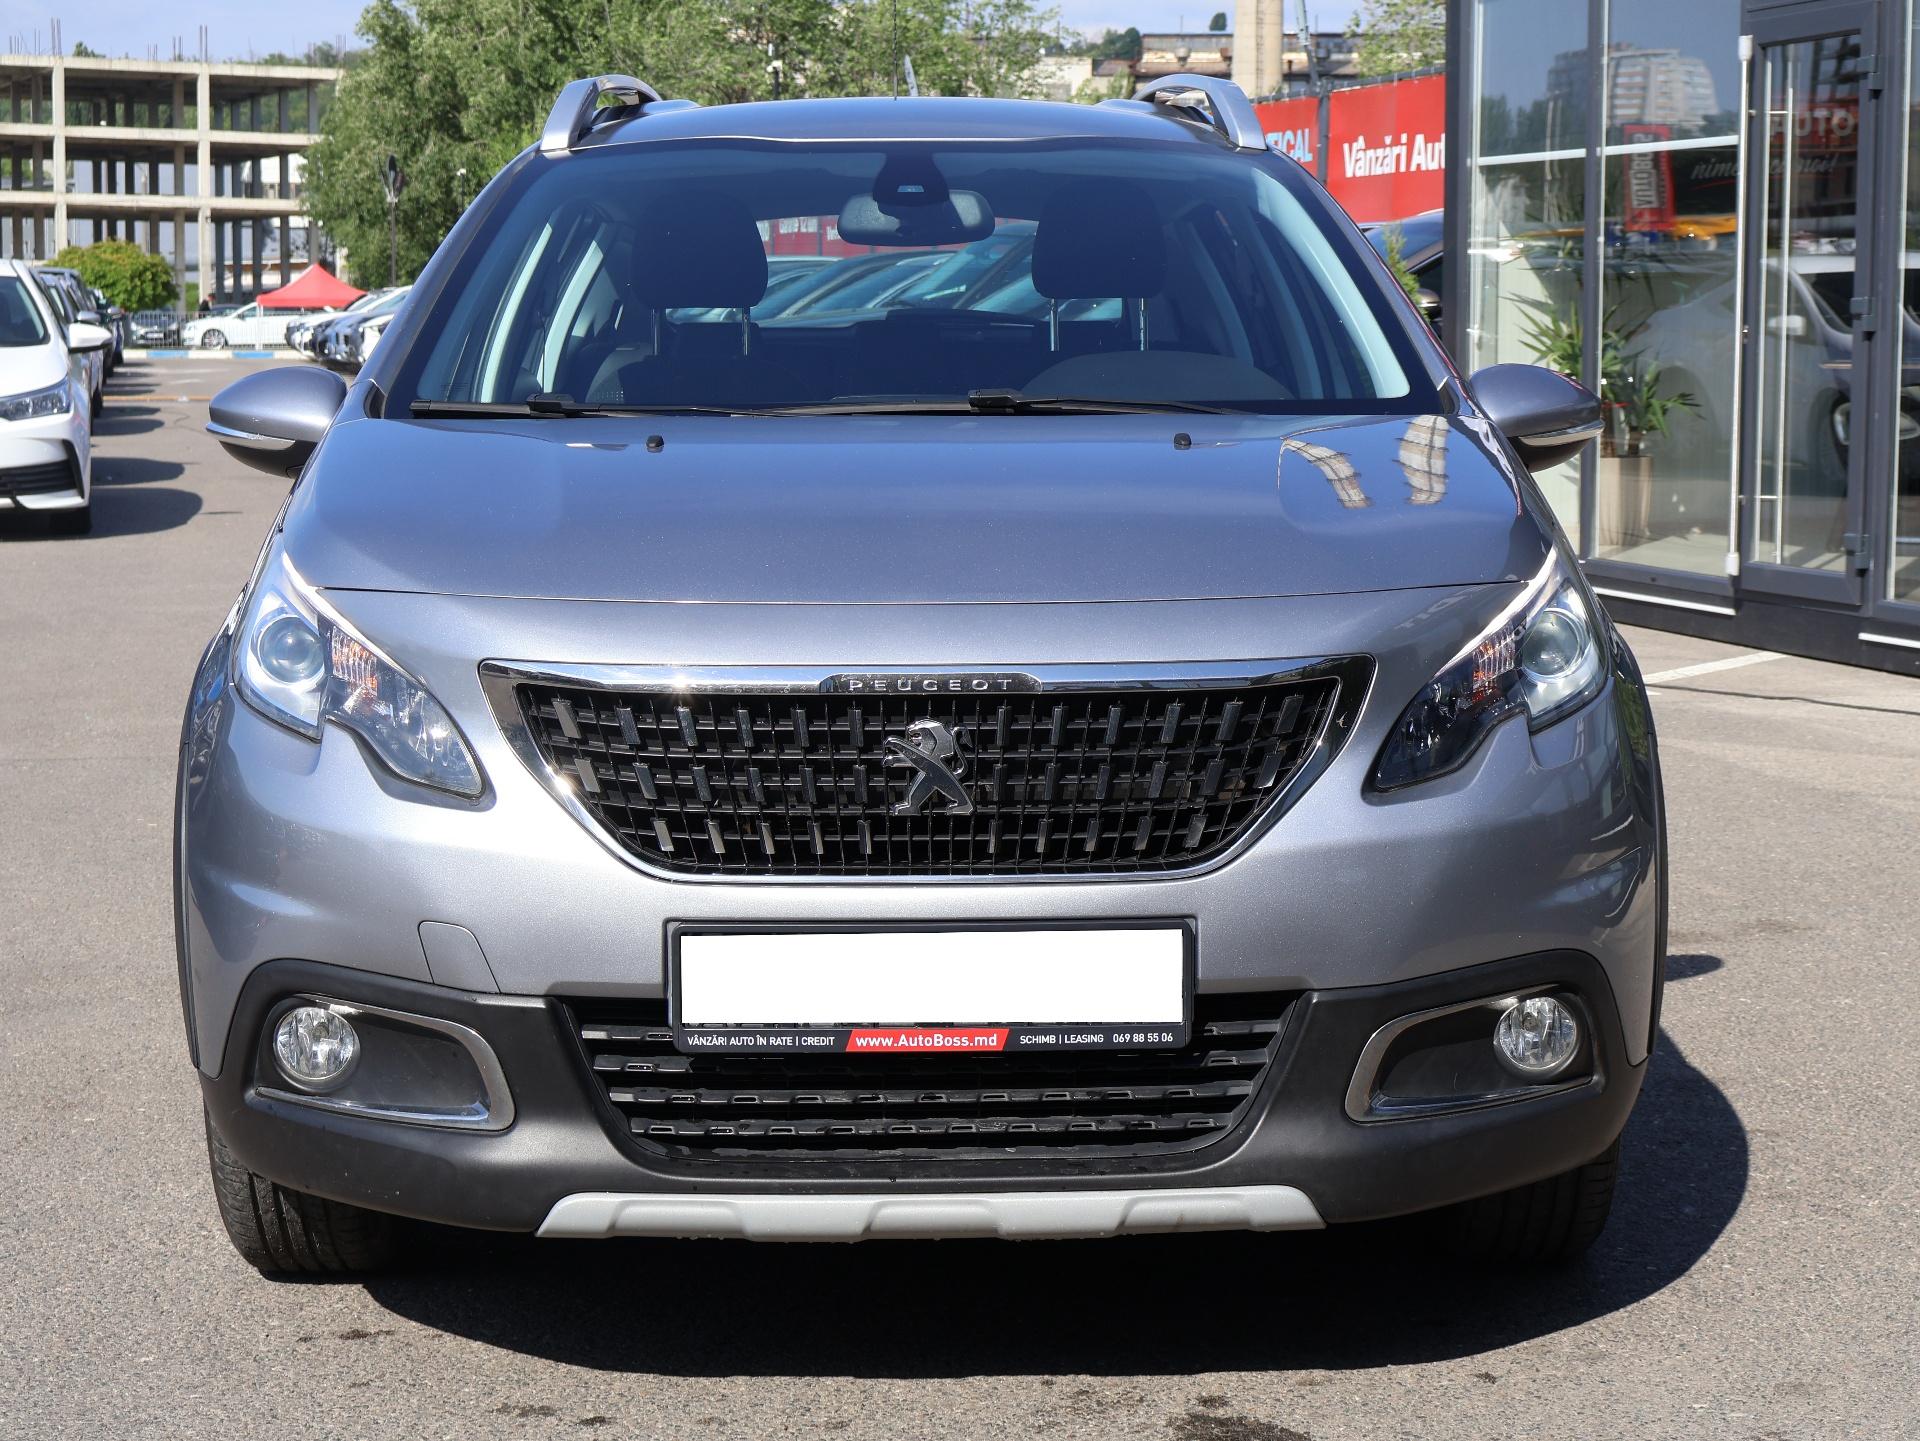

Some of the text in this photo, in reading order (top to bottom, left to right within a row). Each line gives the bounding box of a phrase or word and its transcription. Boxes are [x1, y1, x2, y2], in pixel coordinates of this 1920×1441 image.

[1343, 133, 1408, 178] Vânzări
[849, 679, 1012, 691] PEUGEOT
[687, 1034, 727, 1046] VÂNZĂRI
[729, 1036, 755, 1046] AUTO
[756, 1034, 768, 1046] ÎN
[769, 1036, 793, 1046] RATE
[801, 1036, 835, 1046] CREDIT
[855, 1033, 998, 1047] www.AutoBoss.md
[1019, 1035, 1056, 1044] SCHIMB
[1064, 1034, 1104, 1044] LEASING
[1112, 1033, 1130, 1043] 069
[1132, 1033, 1145, 1043] 88
[1147, 1033, 1159, 1042] 55
[1161, 1032, 1173, 1042] 06
